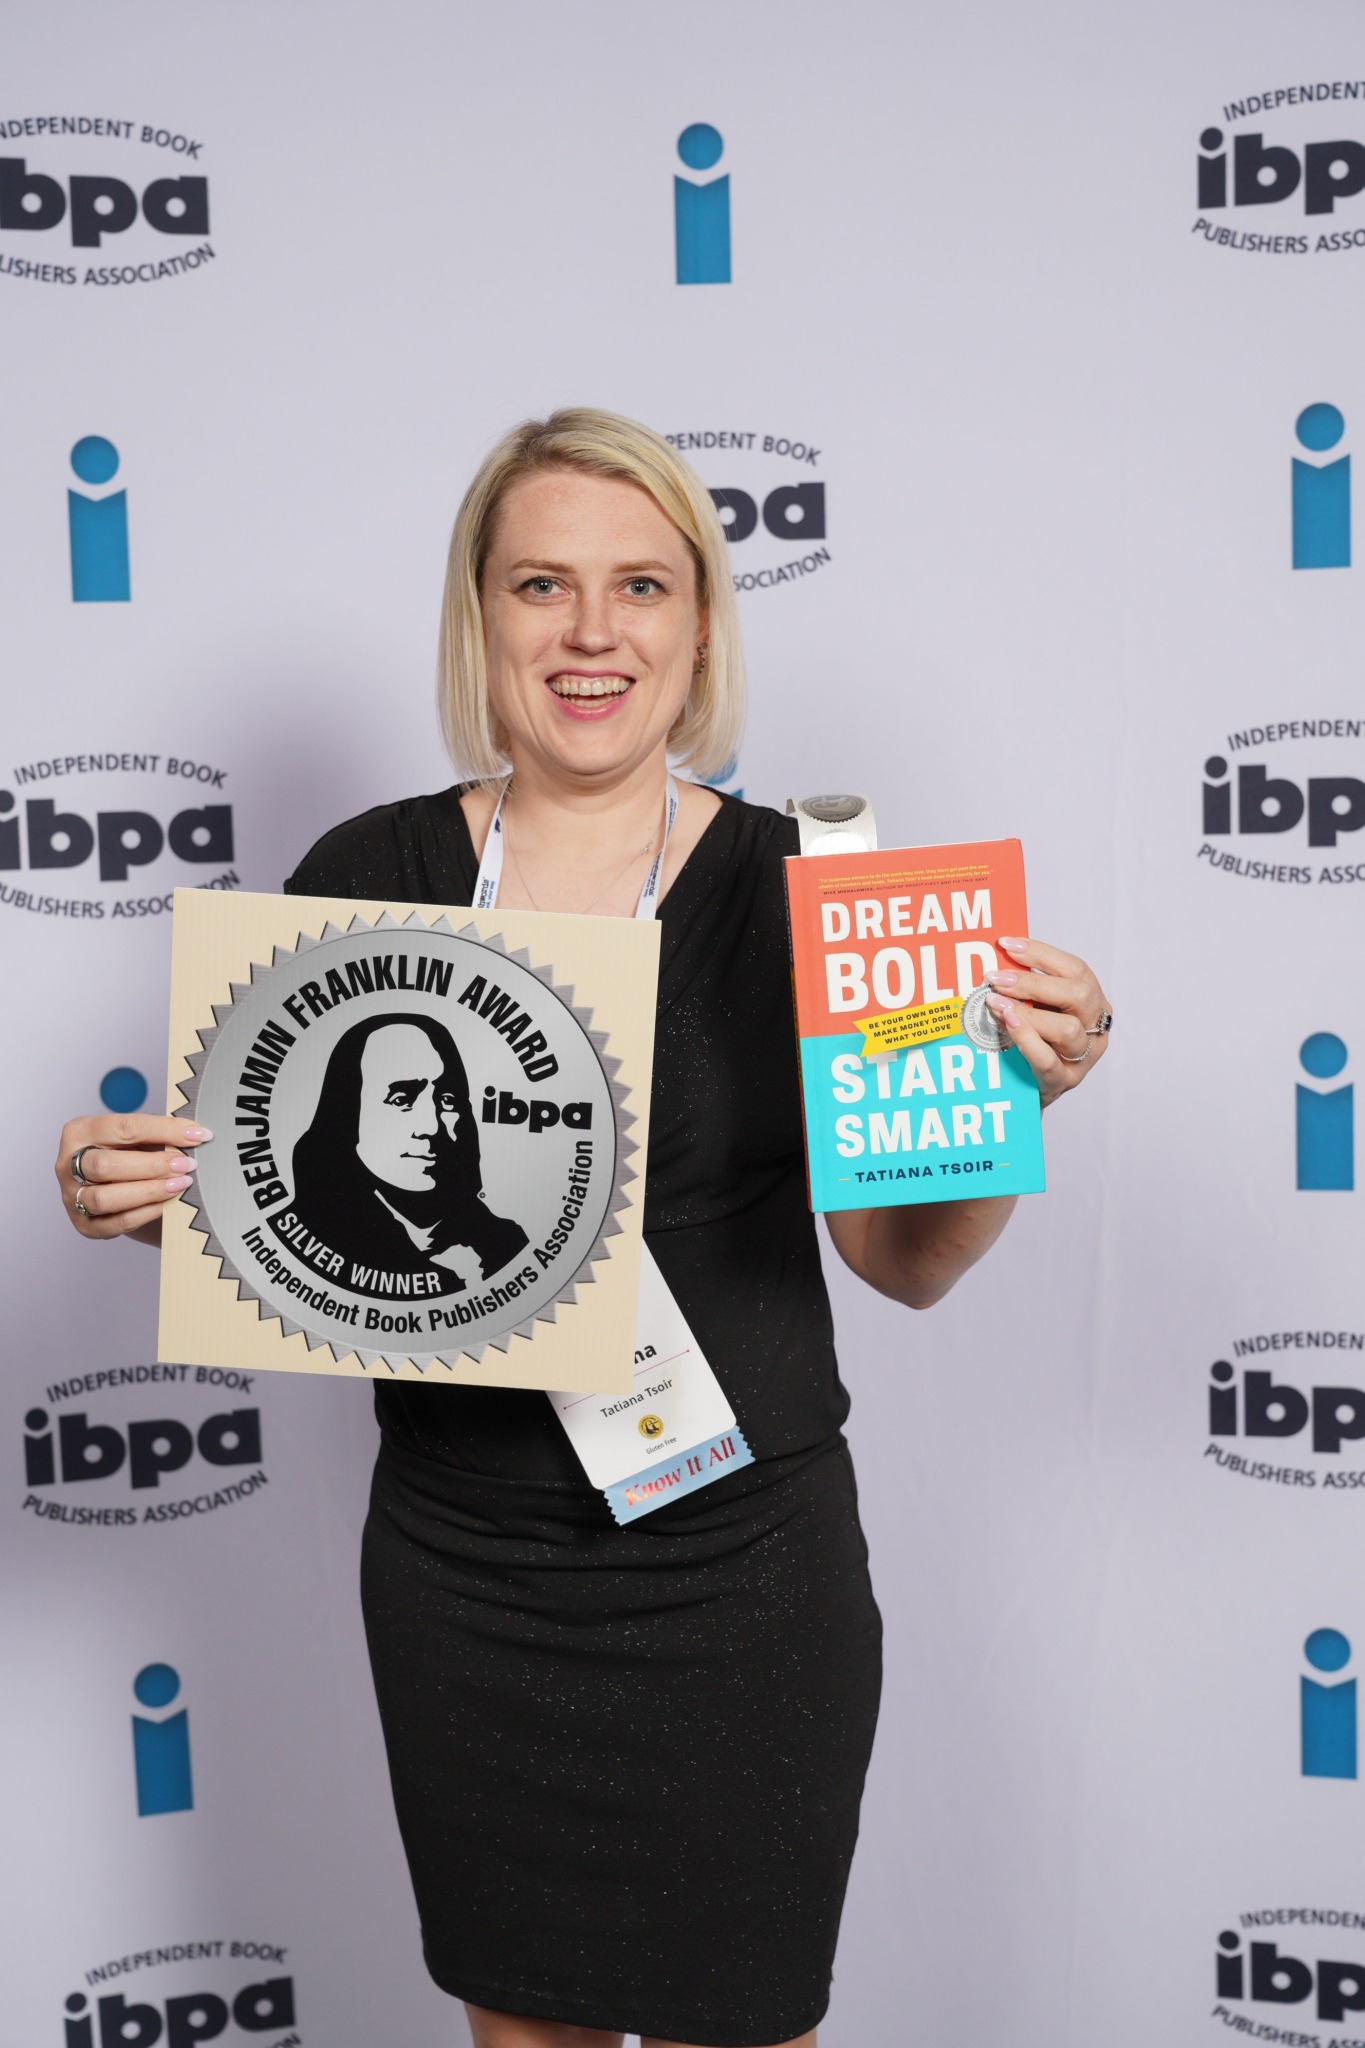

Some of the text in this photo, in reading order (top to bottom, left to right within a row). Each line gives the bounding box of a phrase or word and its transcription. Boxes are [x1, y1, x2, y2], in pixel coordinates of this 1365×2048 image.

[0, 117, 203, 160] DEPENDENT BOOK
[1197, 127, 1365, 215] ibp
[0, 157, 210, 248] bpa
[1192, 218, 1308, 254] PUBLISHERS
[0, 243, 215, 286] LISHERS ASSOCIATION
[763, 436, 821, 467] BOOK
[1227, 720, 1365, 751] INDEPENDEN
[14, 754, 228, 789] INDEPENDENT BOOK
[1202, 755, 1365, 847] ibp
[0, 790, 235, 882] ibpa
[1197, 843, 1311, 884] PUBLISHERS
[0, 884, 105, 919] UBLISHERS
[821, 889, 992, 942] DREAM
[824, 941, 999, 1013] BOLD
[868, 1022, 880, 1030] BE
[881, 1016, 904, 1027] YOUR
[906, 1010, 926, 1021] OWN
[928, 1005, 951, 1015] BOSS
[873, 1013, 959, 1038] MAKE MONEY DOING
[885, 1023, 952, 1044] WHAT YOU LOVE
[234, 954, 559, 1210] BENJAMIN FRANKLIN AWARD
[831, 1045, 1002, 1104] START
[482, 1085, 593, 1133] ibpa
[835, 1101, 1012, 1158] SMART
[855, 1160, 994, 1183] TATIANA TSOIR
[241, 1140, 593, 1334] Independent Book Publishers Association
[276, 1212, 443, 1295] SILVER WINNER
[1233, 1330, 1365, 1357] INDEPENDEN
[46, 1364, 255, 1404] INDEPENDENT BOOK
[600, 1379, 672, 1418] Tatiana Tsoir
[1209, 1359, 1365, 1454] ibp
[24, 1406, 263, 1490] ibpa
[645, 1436, 677, 1455] Gluten Free
[1203, 1442, 1316, 1488] PUBLISHERS
[625, 1436, 736, 1507] Know It All
[22, 1470, 269, 1526] PUBLISHERS ASSOCIATION
[1239, 1908, 1365, 1930] INDEPENDE
[85, 1941, 288, 1987] INDEPENDENT BOOK
[1215, 1930, 1365, 2023] ibp
[64, 1976, 297, 2048] ibpa
